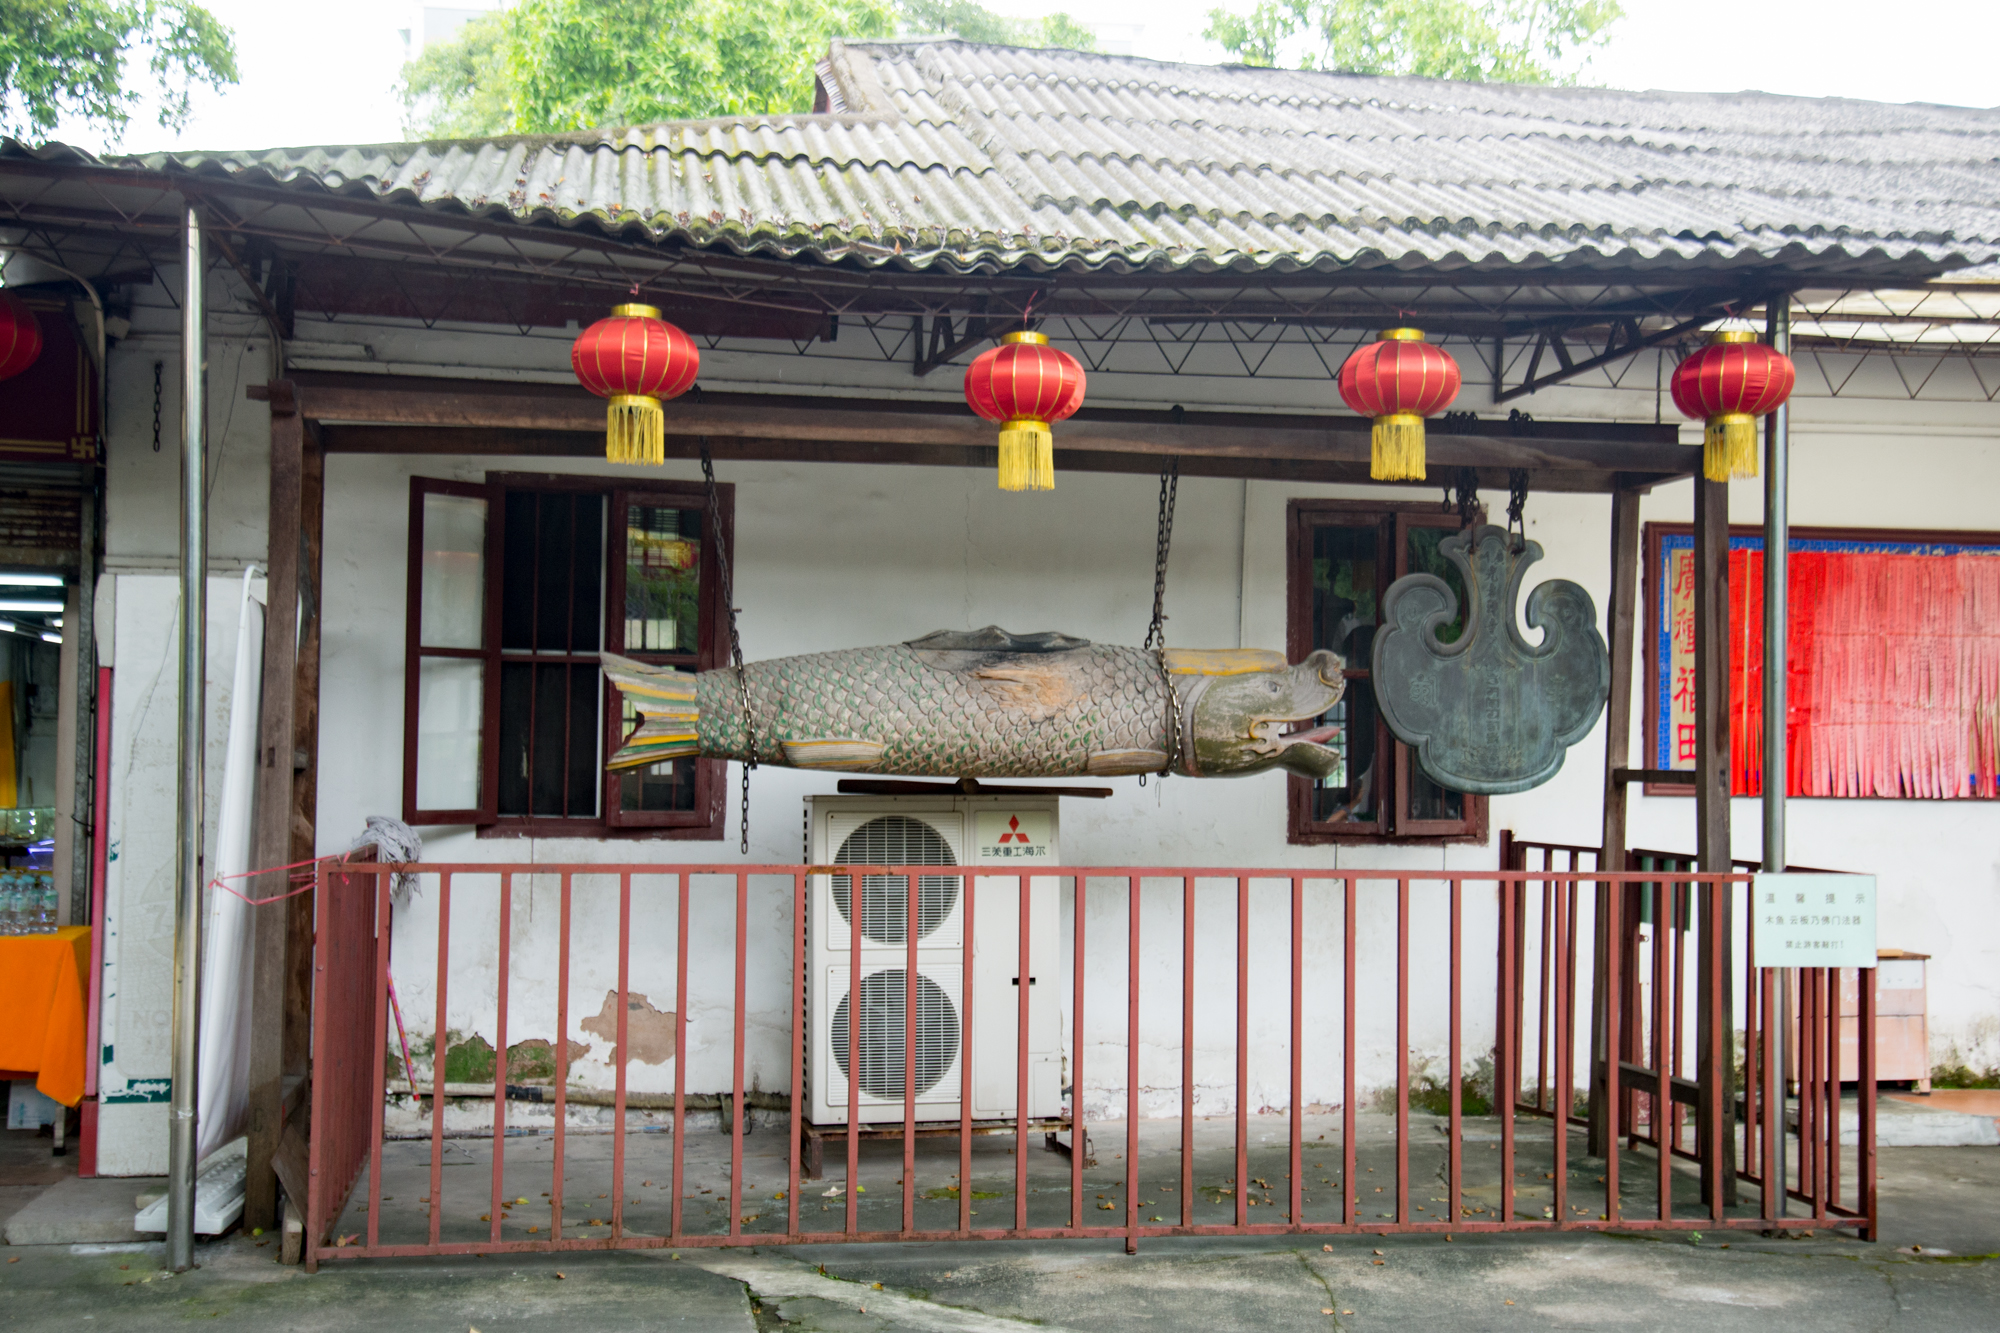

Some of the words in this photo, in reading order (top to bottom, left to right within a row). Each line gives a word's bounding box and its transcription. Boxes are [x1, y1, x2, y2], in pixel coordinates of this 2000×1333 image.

[982, 846, 1046, 857] 三菱重工海尔
[1765, 893, 1865, 904] 温馨提示
